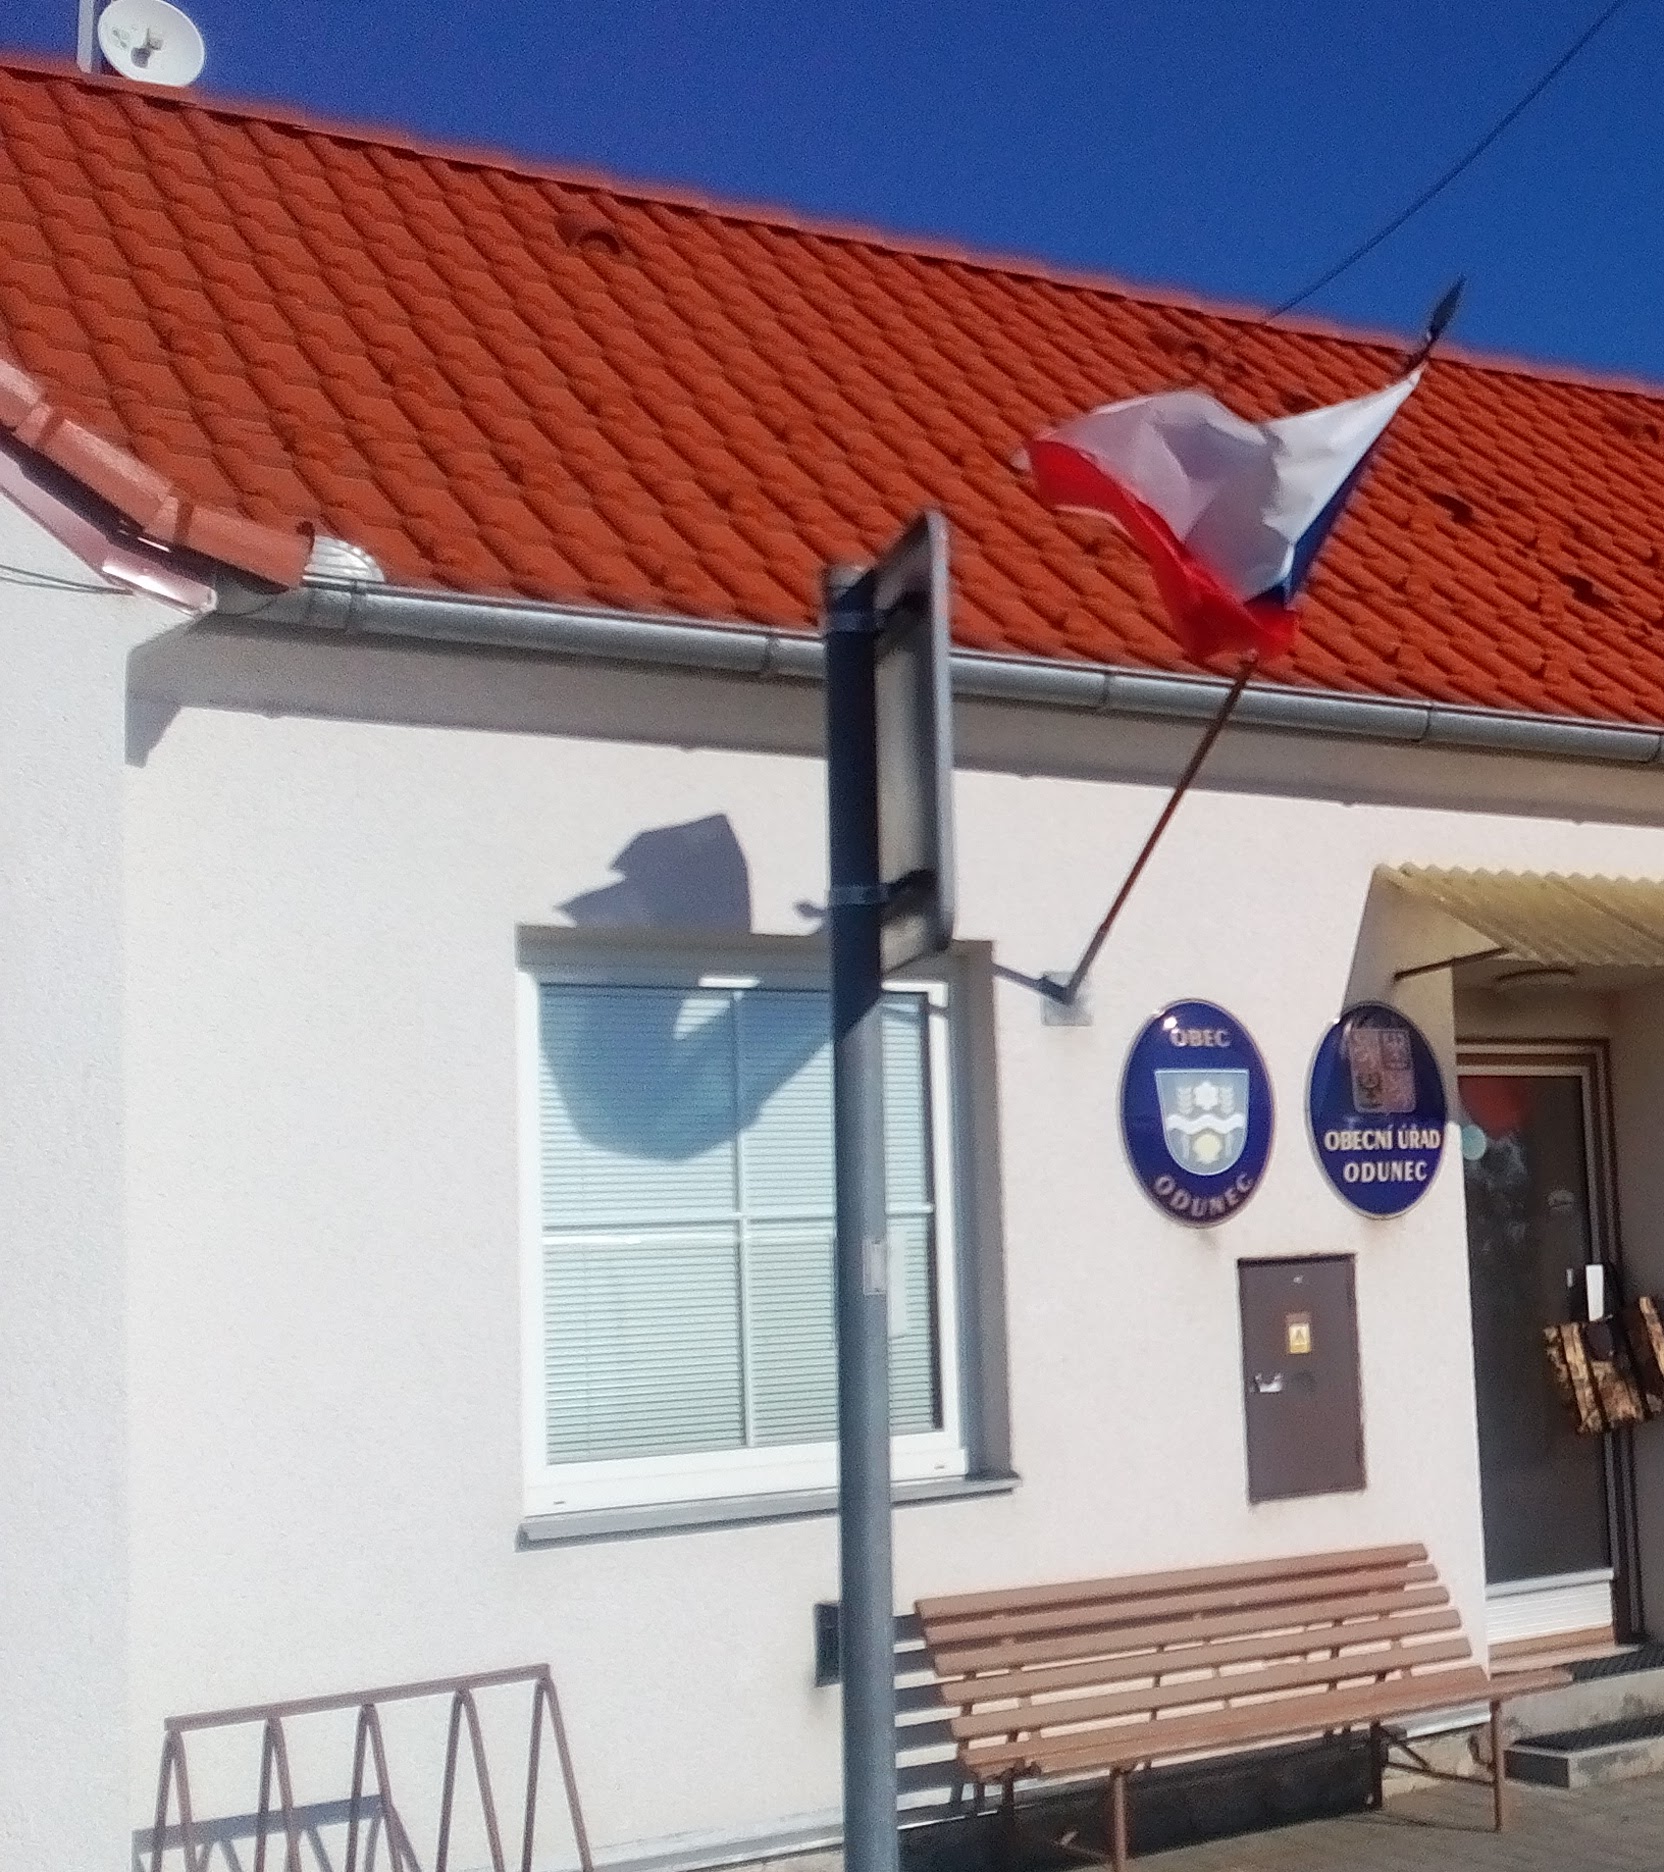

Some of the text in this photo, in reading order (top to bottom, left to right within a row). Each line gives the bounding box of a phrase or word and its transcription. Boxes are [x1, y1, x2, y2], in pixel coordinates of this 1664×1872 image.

[1169, 1028, 1231, 1047] OBEC
[1324, 1124, 1393, 1151] OBECNÍ
[1343, 1161, 1428, 1183] ODUNEC
[1154, 1173, 1252, 1217] ODUNEC
